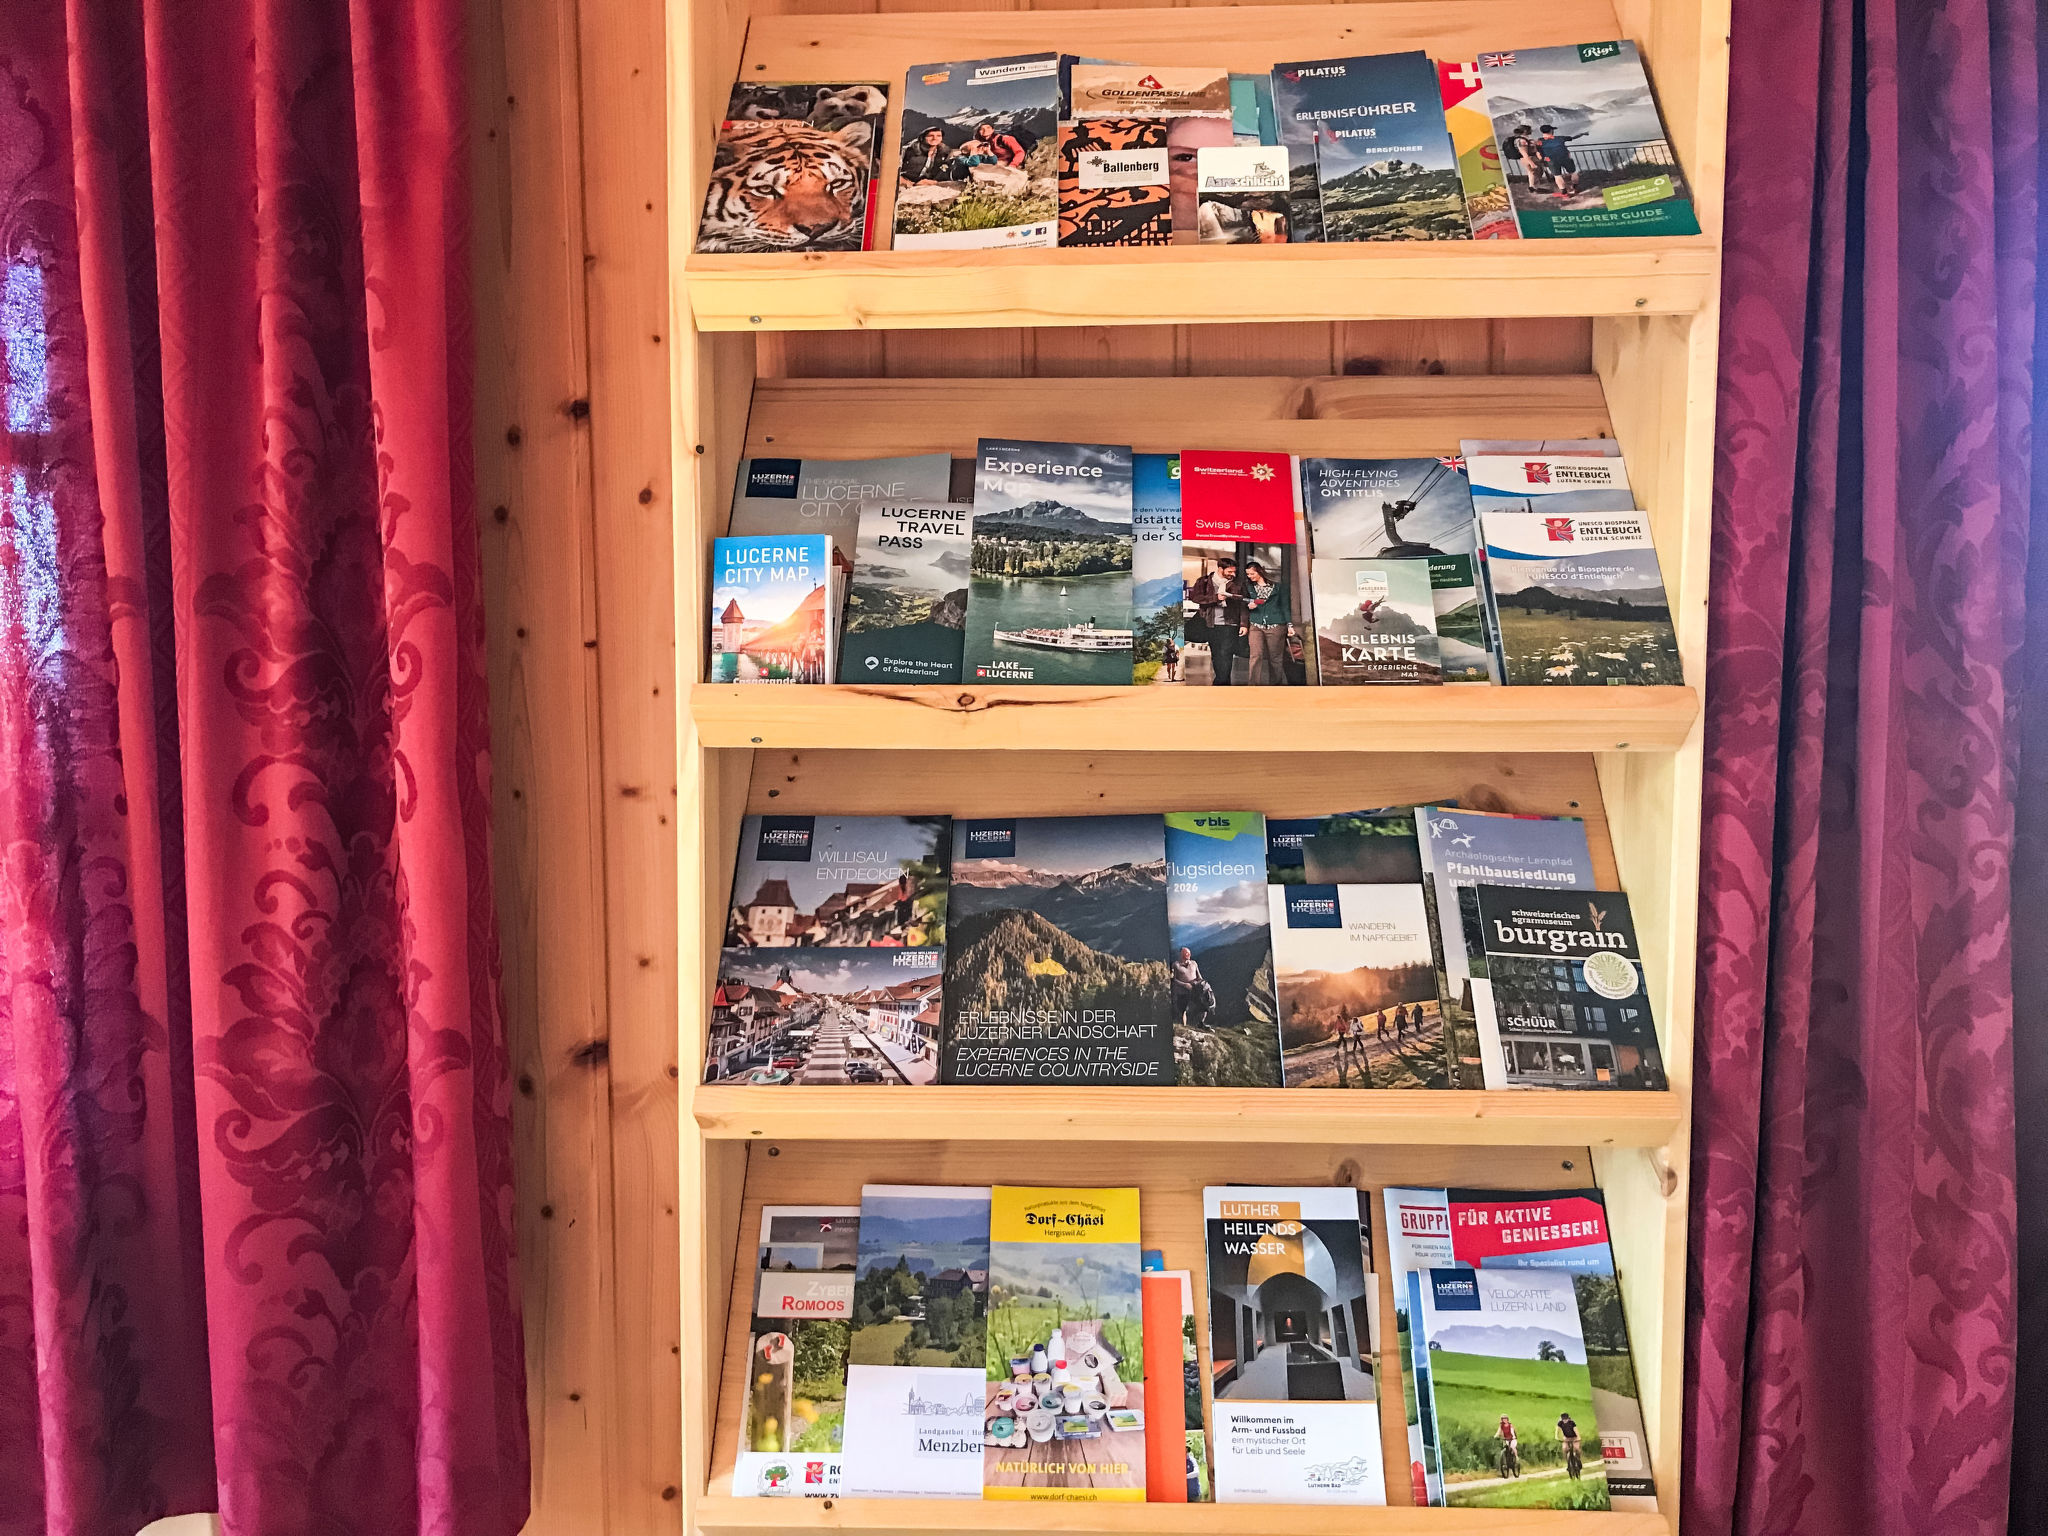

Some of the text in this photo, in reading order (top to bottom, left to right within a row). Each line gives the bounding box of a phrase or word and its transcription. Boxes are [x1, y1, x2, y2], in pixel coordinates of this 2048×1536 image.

[1582, 44, 1615, 58] Rigi
[979, 64, 1026, 76] Wandern
[1298, 66, 1346, 77] PILATUS
[1296, 101, 1417, 121] ERLEBNISFÜHRER
[1335, 128, 1376, 138] PILATUS
[1365, 145, 1423, 154] BERGFÜHRER
[1103, 161, 1160, 173] Ballenberg
[1204, 174, 1285, 188] Aareschlucht
[1551, 208, 1665, 223] EXPLORER GUIDE
[984, 456, 1104, 477] Experience
[1319, 469, 1398, 478] HIGH-FLYING
[1556, 471, 1611, 479] ENTLEBUCH
[983, 479, 1031, 498] Map
[1319, 479, 1401, 488] ADVENTURES
[802, 481, 906, 500] LUCERNE
[1320, 488, 1384, 498] ON TITLIS
[800, 501, 851, 517] CITY
[881, 507, 967, 521] LUCERNE
[897, 521, 966, 536] TRAVEL
[1195, 519, 1264, 531] Swiss Pass
[1579, 526, 1641, 535] ENTLEBUCH
[878, 534, 924, 549] PASS
[1142, 531, 1165, 541] der
[726, 546, 809, 565] LUCERNE
[725, 566, 809, 584] CITY MAP
[1511, 565, 1557, 573] Bienvenue
[1578, 565, 1621, 574] Biosphère
[1340, 634, 1416, 645] ERLEBNIS
[1342, 646, 1417, 662] KARTE
[883, 657, 953, 670] Explore the Heart
[992, 660, 1019, 670] LAKE
[893, 667, 940, 676] Switzerland
[986, 670, 1034, 679] LUCERNE
[1208, 816, 1231, 827] bls
[763, 832, 804, 840] LUZERN
[818, 850, 888, 863] WILLISAU
[1527, 855, 1573, 867] Lernpfad
[816, 867, 910, 881] ENTDECKEN
[1166, 861, 1255, 879] flugsideen
[1446, 862, 1576, 885] Pfahlbausiedlung
[1173, 882, 1199, 893] 2026
[1511, 909, 1581, 920] schweizerisches
[1512, 916, 1573, 926] agrarmuseum
[1350, 933, 1419, 942] IM NAPFGEBIET
[1493, 920, 1628, 953] burgrain
[959, 1009, 1116, 1025] ERLEBNISSE IN DER
[1507, 1015, 1557, 1028] SCHÜÜR
[958, 1024, 1158, 1040] LUZERNER LANDSCHAFT
[956, 1046, 1129, 1061] EXPERIENCES IN THE
[955, 1061, 1160, 1077] LUCERNE COUNTRYSIDE
[1223, 1204, 1280, 1217] LUTHER
[1458, 1206, 1552, 1226] FÜR AKTIVE
[1044, 1229, 1075, 1238] Hergiswil
[1224, 1222, 1297, 1236] HEILENDS
[1502, 1219, 1600, 1244] GENIESSER!
[1224, 1241, 1287, 1255] WASSER
[1567, 1258, 1586, 1266] rund
[1487, 1288, 1551, 1299] VELOKARTE
[782, 1295, 845, 1311] ROMOOS
[1490, 1301, 1567, 1312] LUZERN LAND
[1230, 1415, 1294, 1424] Willkommen im
[919, 1428, 964, 1436] Landgasthof
[1231, 1426, 1307, 1435] Arm- und Fussbad
[918, 1438, 985, 1453] Menzber
[1246, 1436, 1290, 1446] mystischer
[1291, 1437, 1306, 1445] Ort
[1245, 1447, 1264, 1455] Leib
[1265, 1447, 1282, 1455] und
[1282, 1447, 1306, 1456] Seele
[995, 1460, 1065, 1474] NATÜRLICH
[1068, 1463, 1096, 1474] VON
